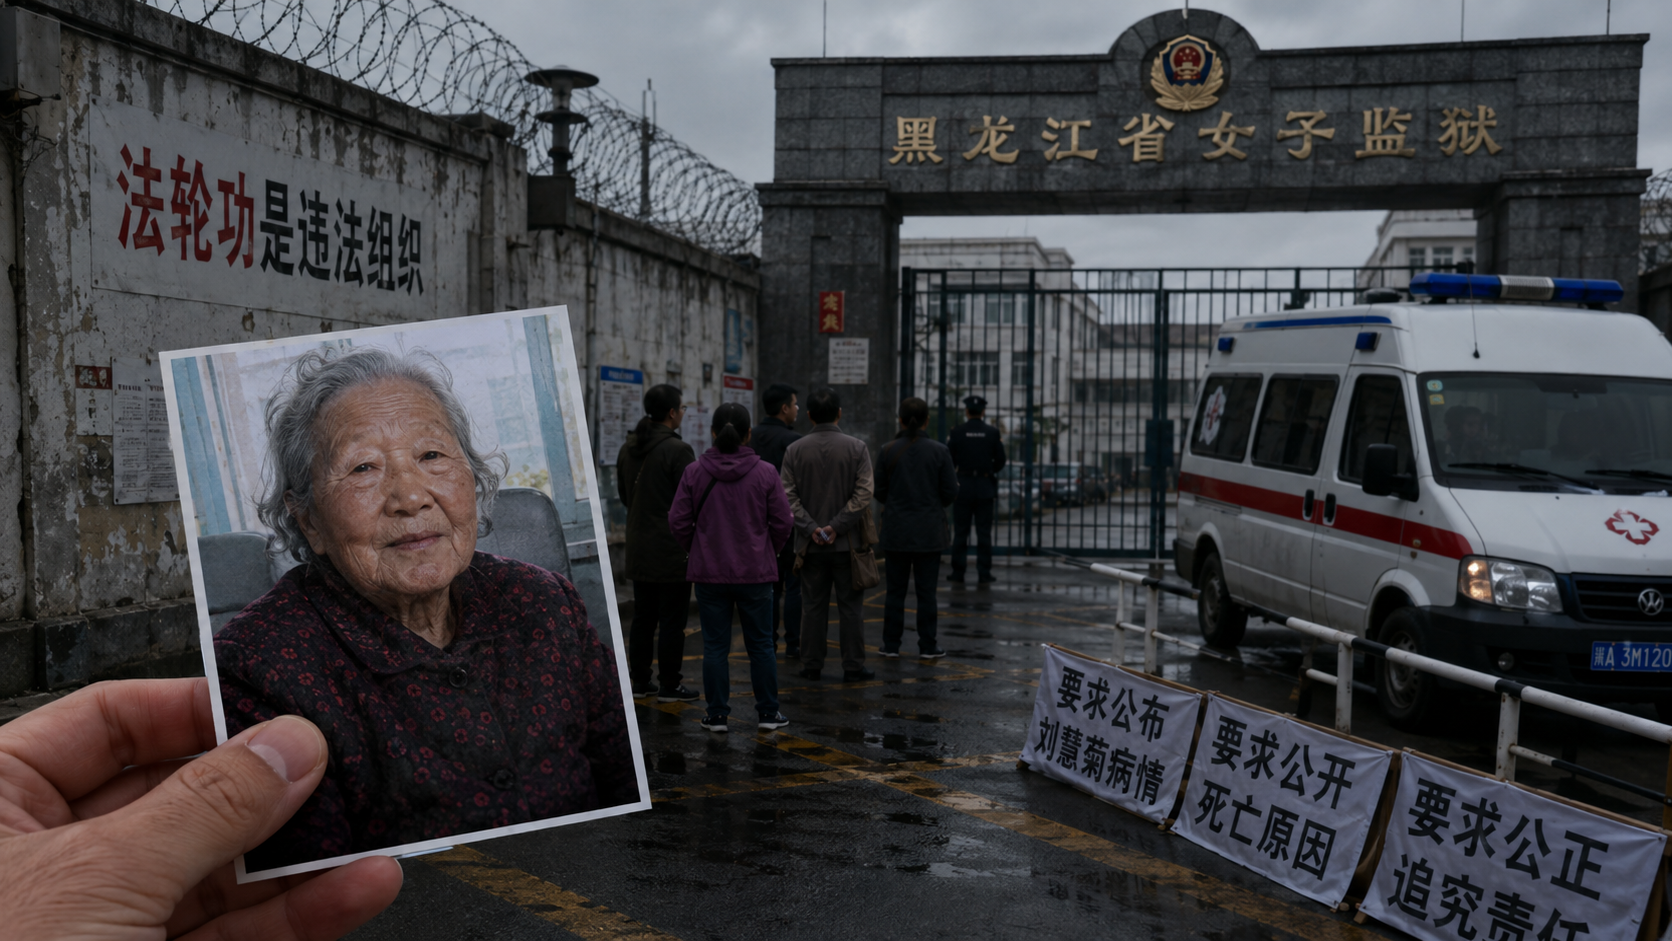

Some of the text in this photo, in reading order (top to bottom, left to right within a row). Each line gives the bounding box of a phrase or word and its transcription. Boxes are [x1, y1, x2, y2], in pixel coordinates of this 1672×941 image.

[888, 104, 1502, 165] 黑龙江省女子监狱
[116, 143, 424, 297] 法轮功是违法组织
[1621, 647, 1672, 668] 3M120
[1057, 666, 1170, 743] 要求公布
[1034, 716, 1166, 806] 刘慧菊病情
[1211, 715, 1356, 810] 要求公开
[1194, 779, 1337, 881] 死亡原因
[1408, 777, 1610, 901] 要求公正
